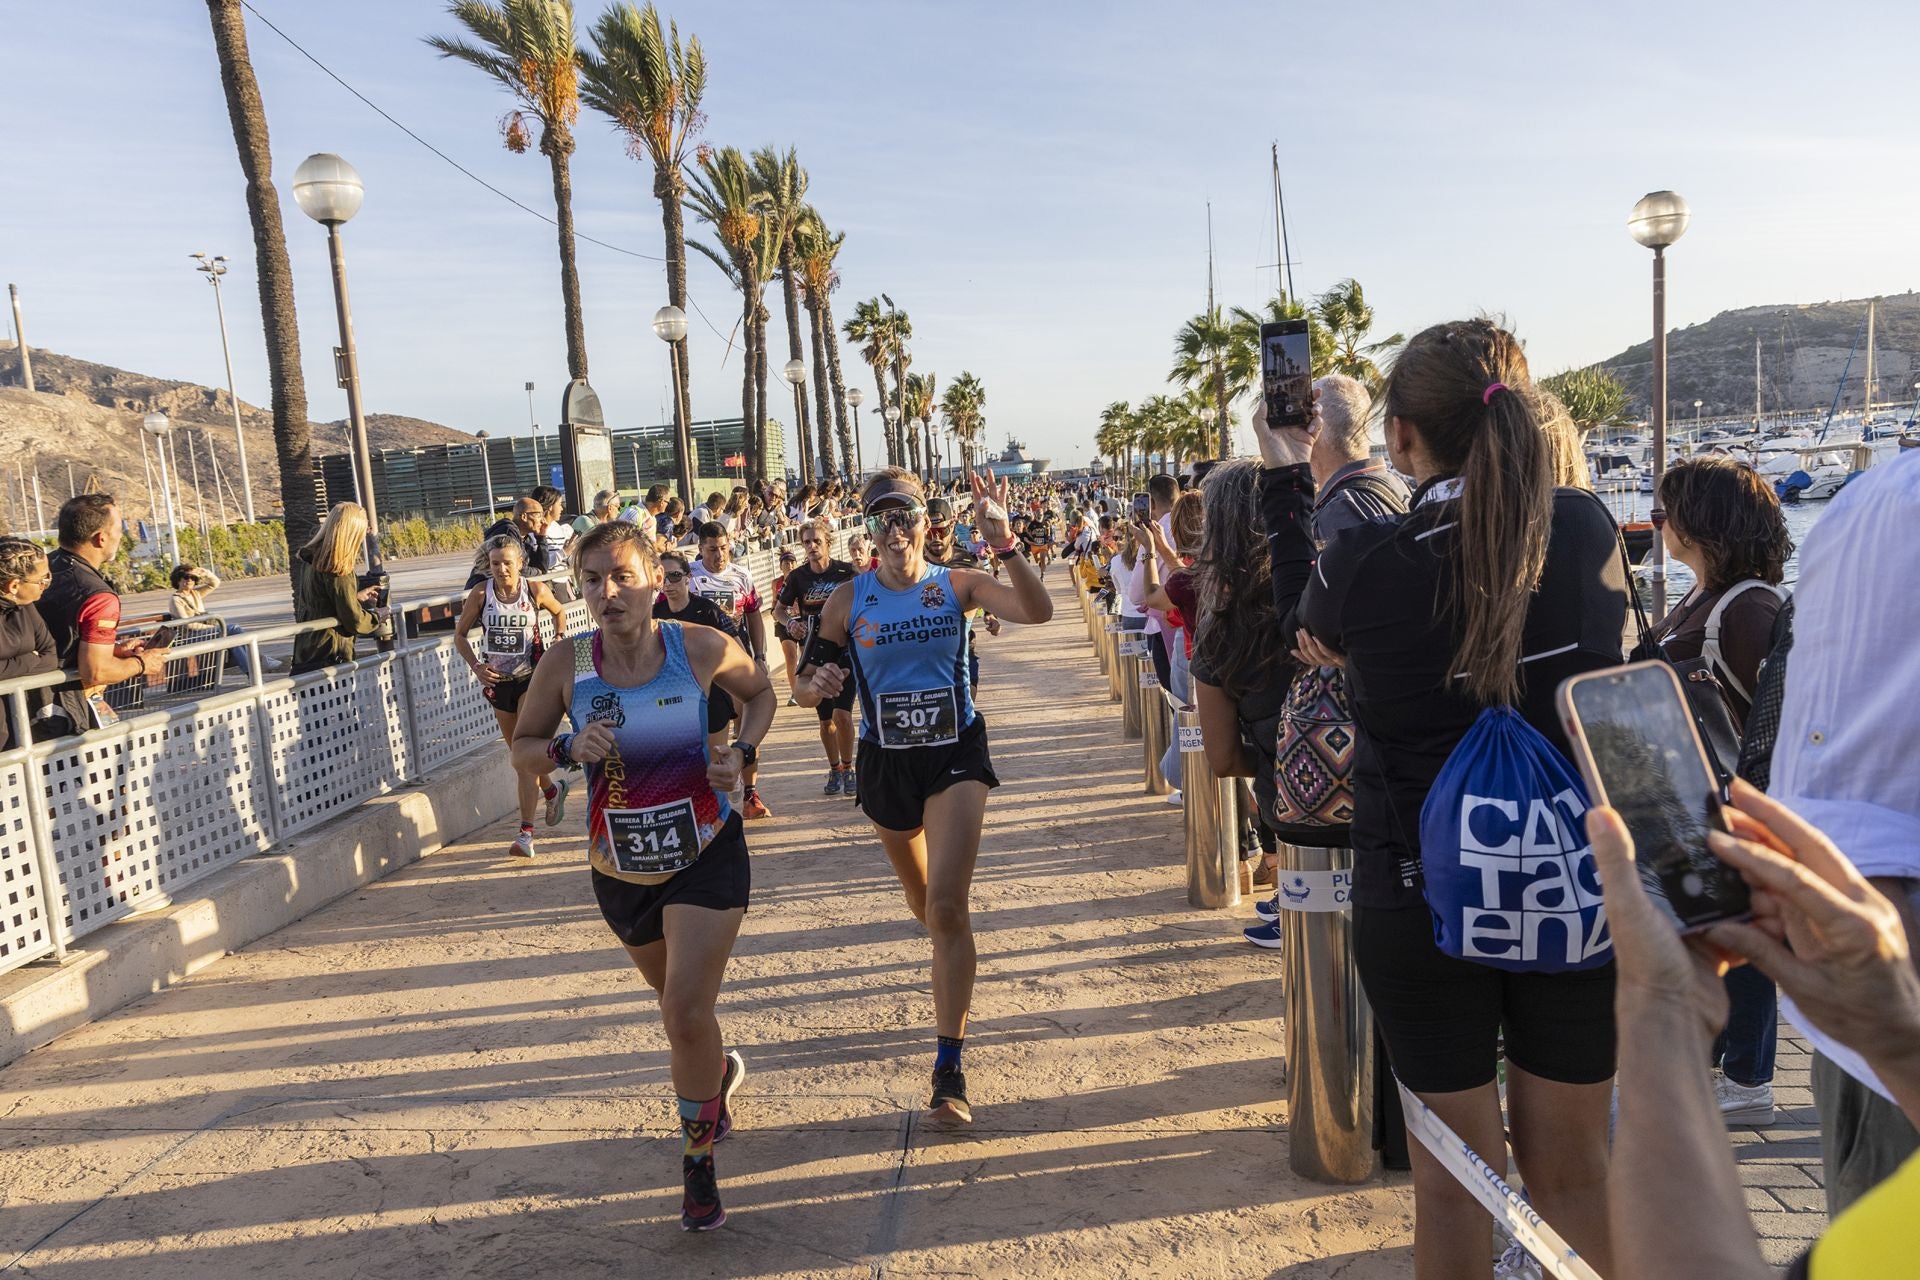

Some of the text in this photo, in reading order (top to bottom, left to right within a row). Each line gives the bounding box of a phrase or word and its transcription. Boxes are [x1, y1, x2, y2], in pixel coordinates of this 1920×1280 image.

[708, 598, 728, 606] 47
[488, 614, 528, 627] UNED
[866, 614, 954, 634] Marathon
[494, 635, 517, 645] 839
[855, 617, 958, 648] Cartagena
[910, 693, 922, 703] IX
[895, 706, 941, 729] 307
[614, 808, 687, 824] CARRERA IX SOLIDARIA
[627, 826, 681, 853] 314
